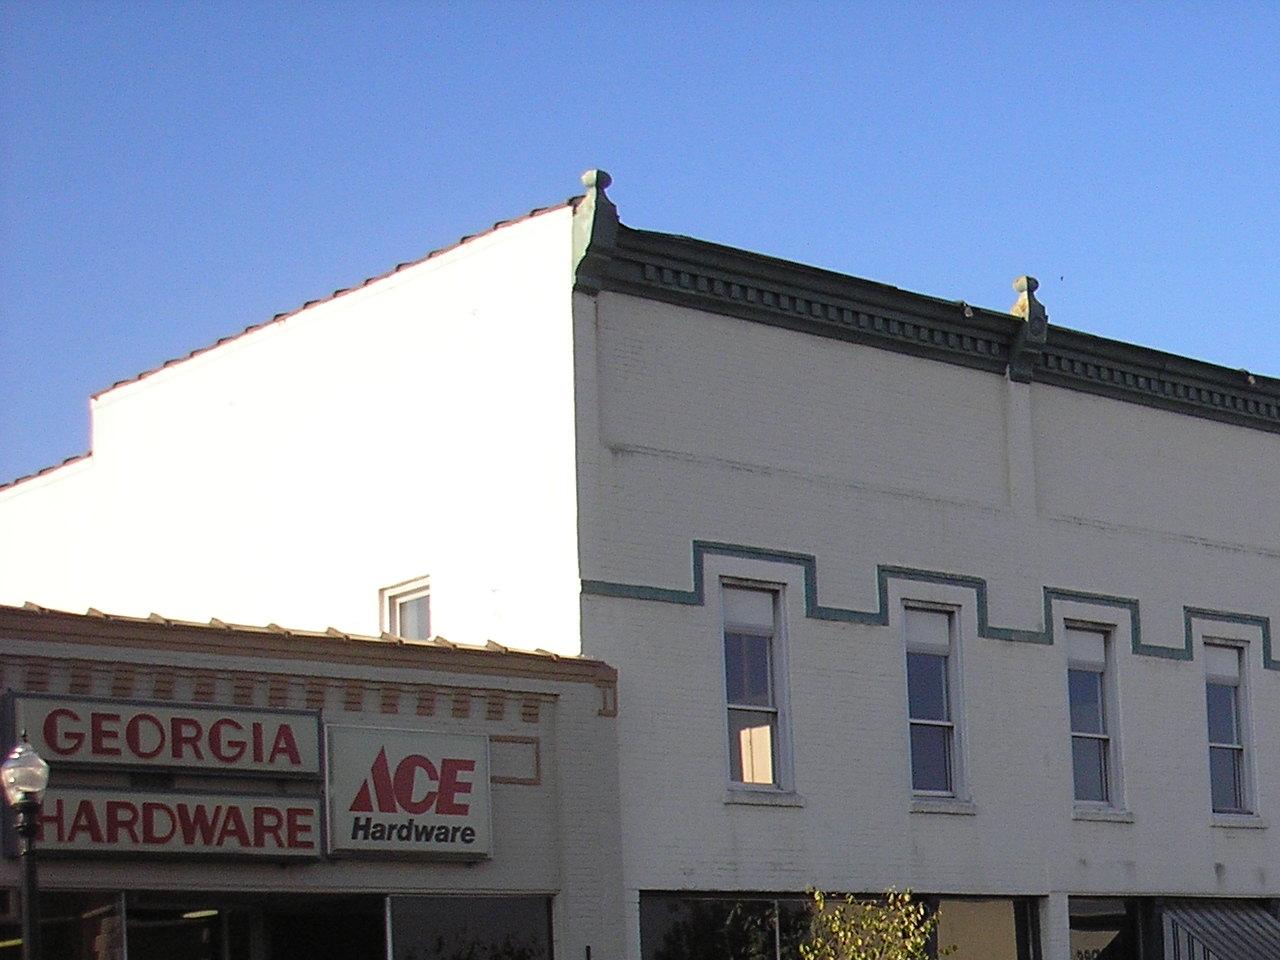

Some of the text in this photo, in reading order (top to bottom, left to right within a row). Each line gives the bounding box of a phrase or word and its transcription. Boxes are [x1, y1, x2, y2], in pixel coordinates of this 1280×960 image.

[42, 708, 302, 766] GEORGIA
[348, 745, 476, 816] ACE
[35, 798, 316, 849] HARDWARE
[350, 816, 476, 844] Hardware
